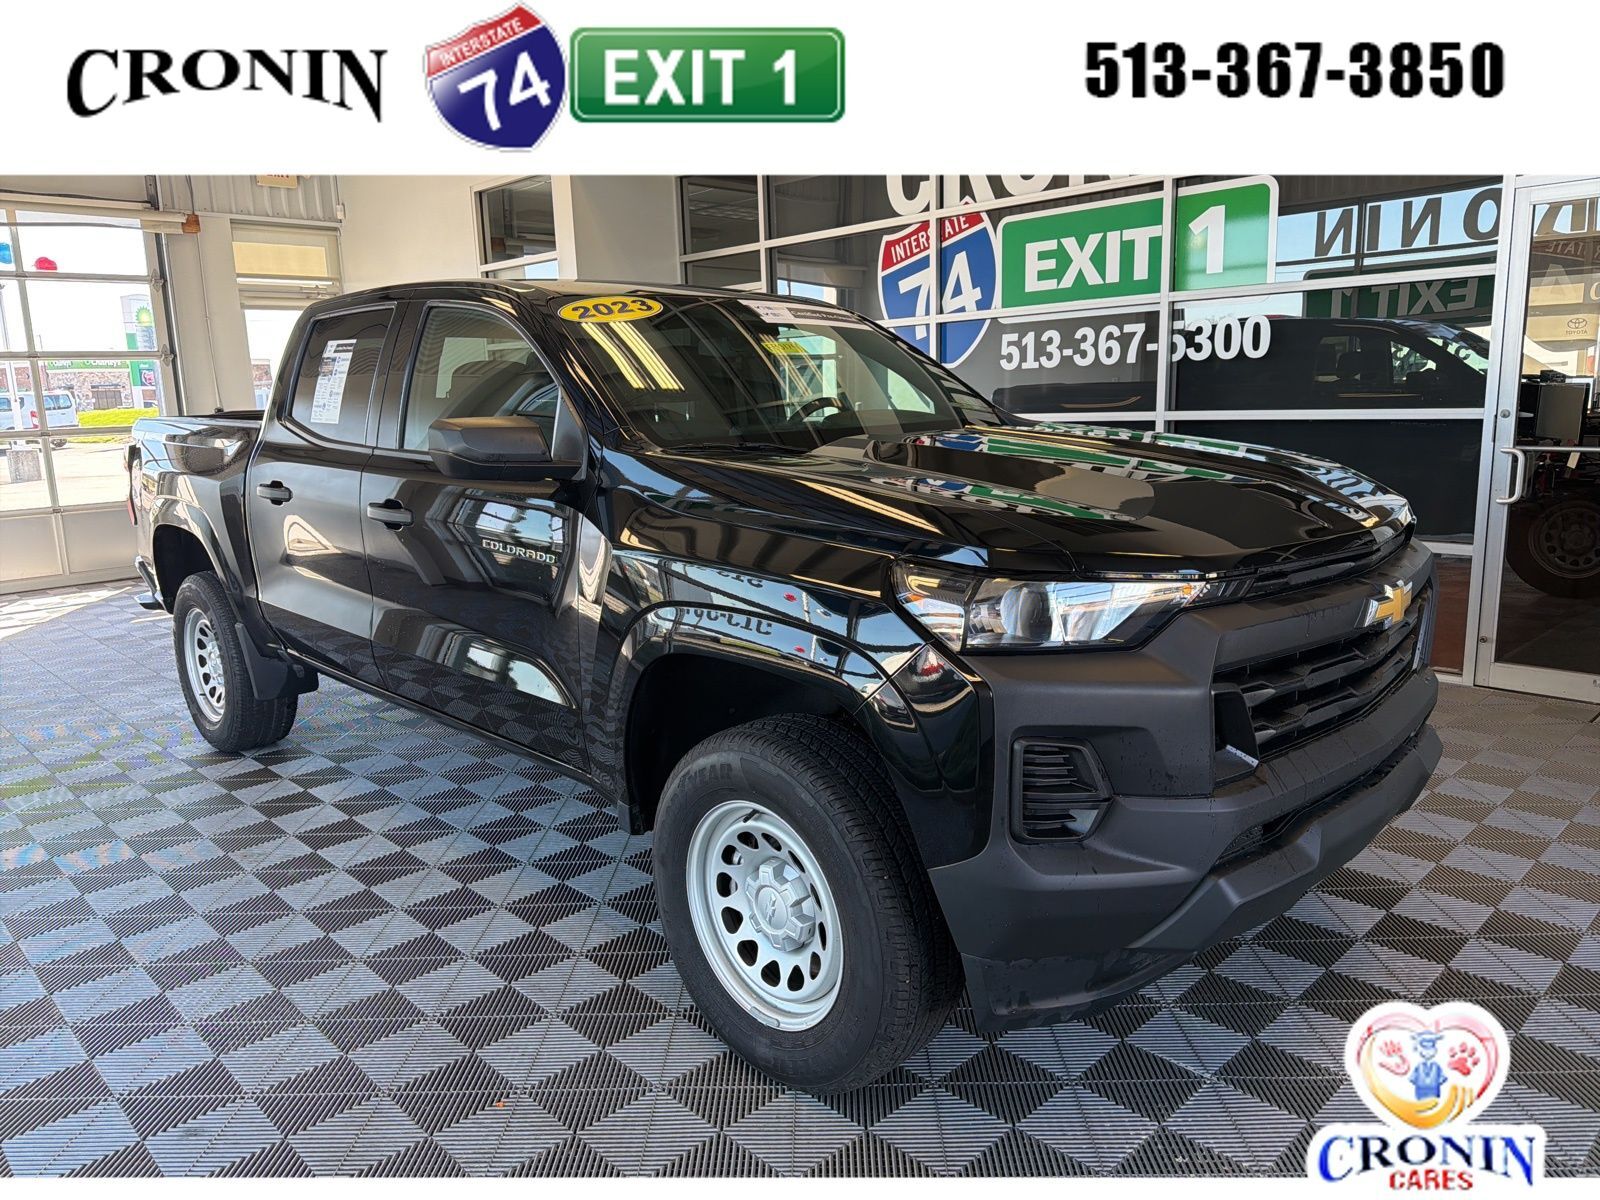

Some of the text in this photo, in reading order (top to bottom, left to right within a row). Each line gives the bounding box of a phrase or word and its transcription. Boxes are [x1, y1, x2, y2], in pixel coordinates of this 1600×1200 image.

[891, 216, 969, 263] INTERATE
[1025, 204, 1226, 293] EXIT 1
[571, 299, 655, 319] 2023
[898, 251, 982, 340] 74
[1000, 314, 1271, 370] 513-367-5300
[482, 538, 556, 563] COLORADO
